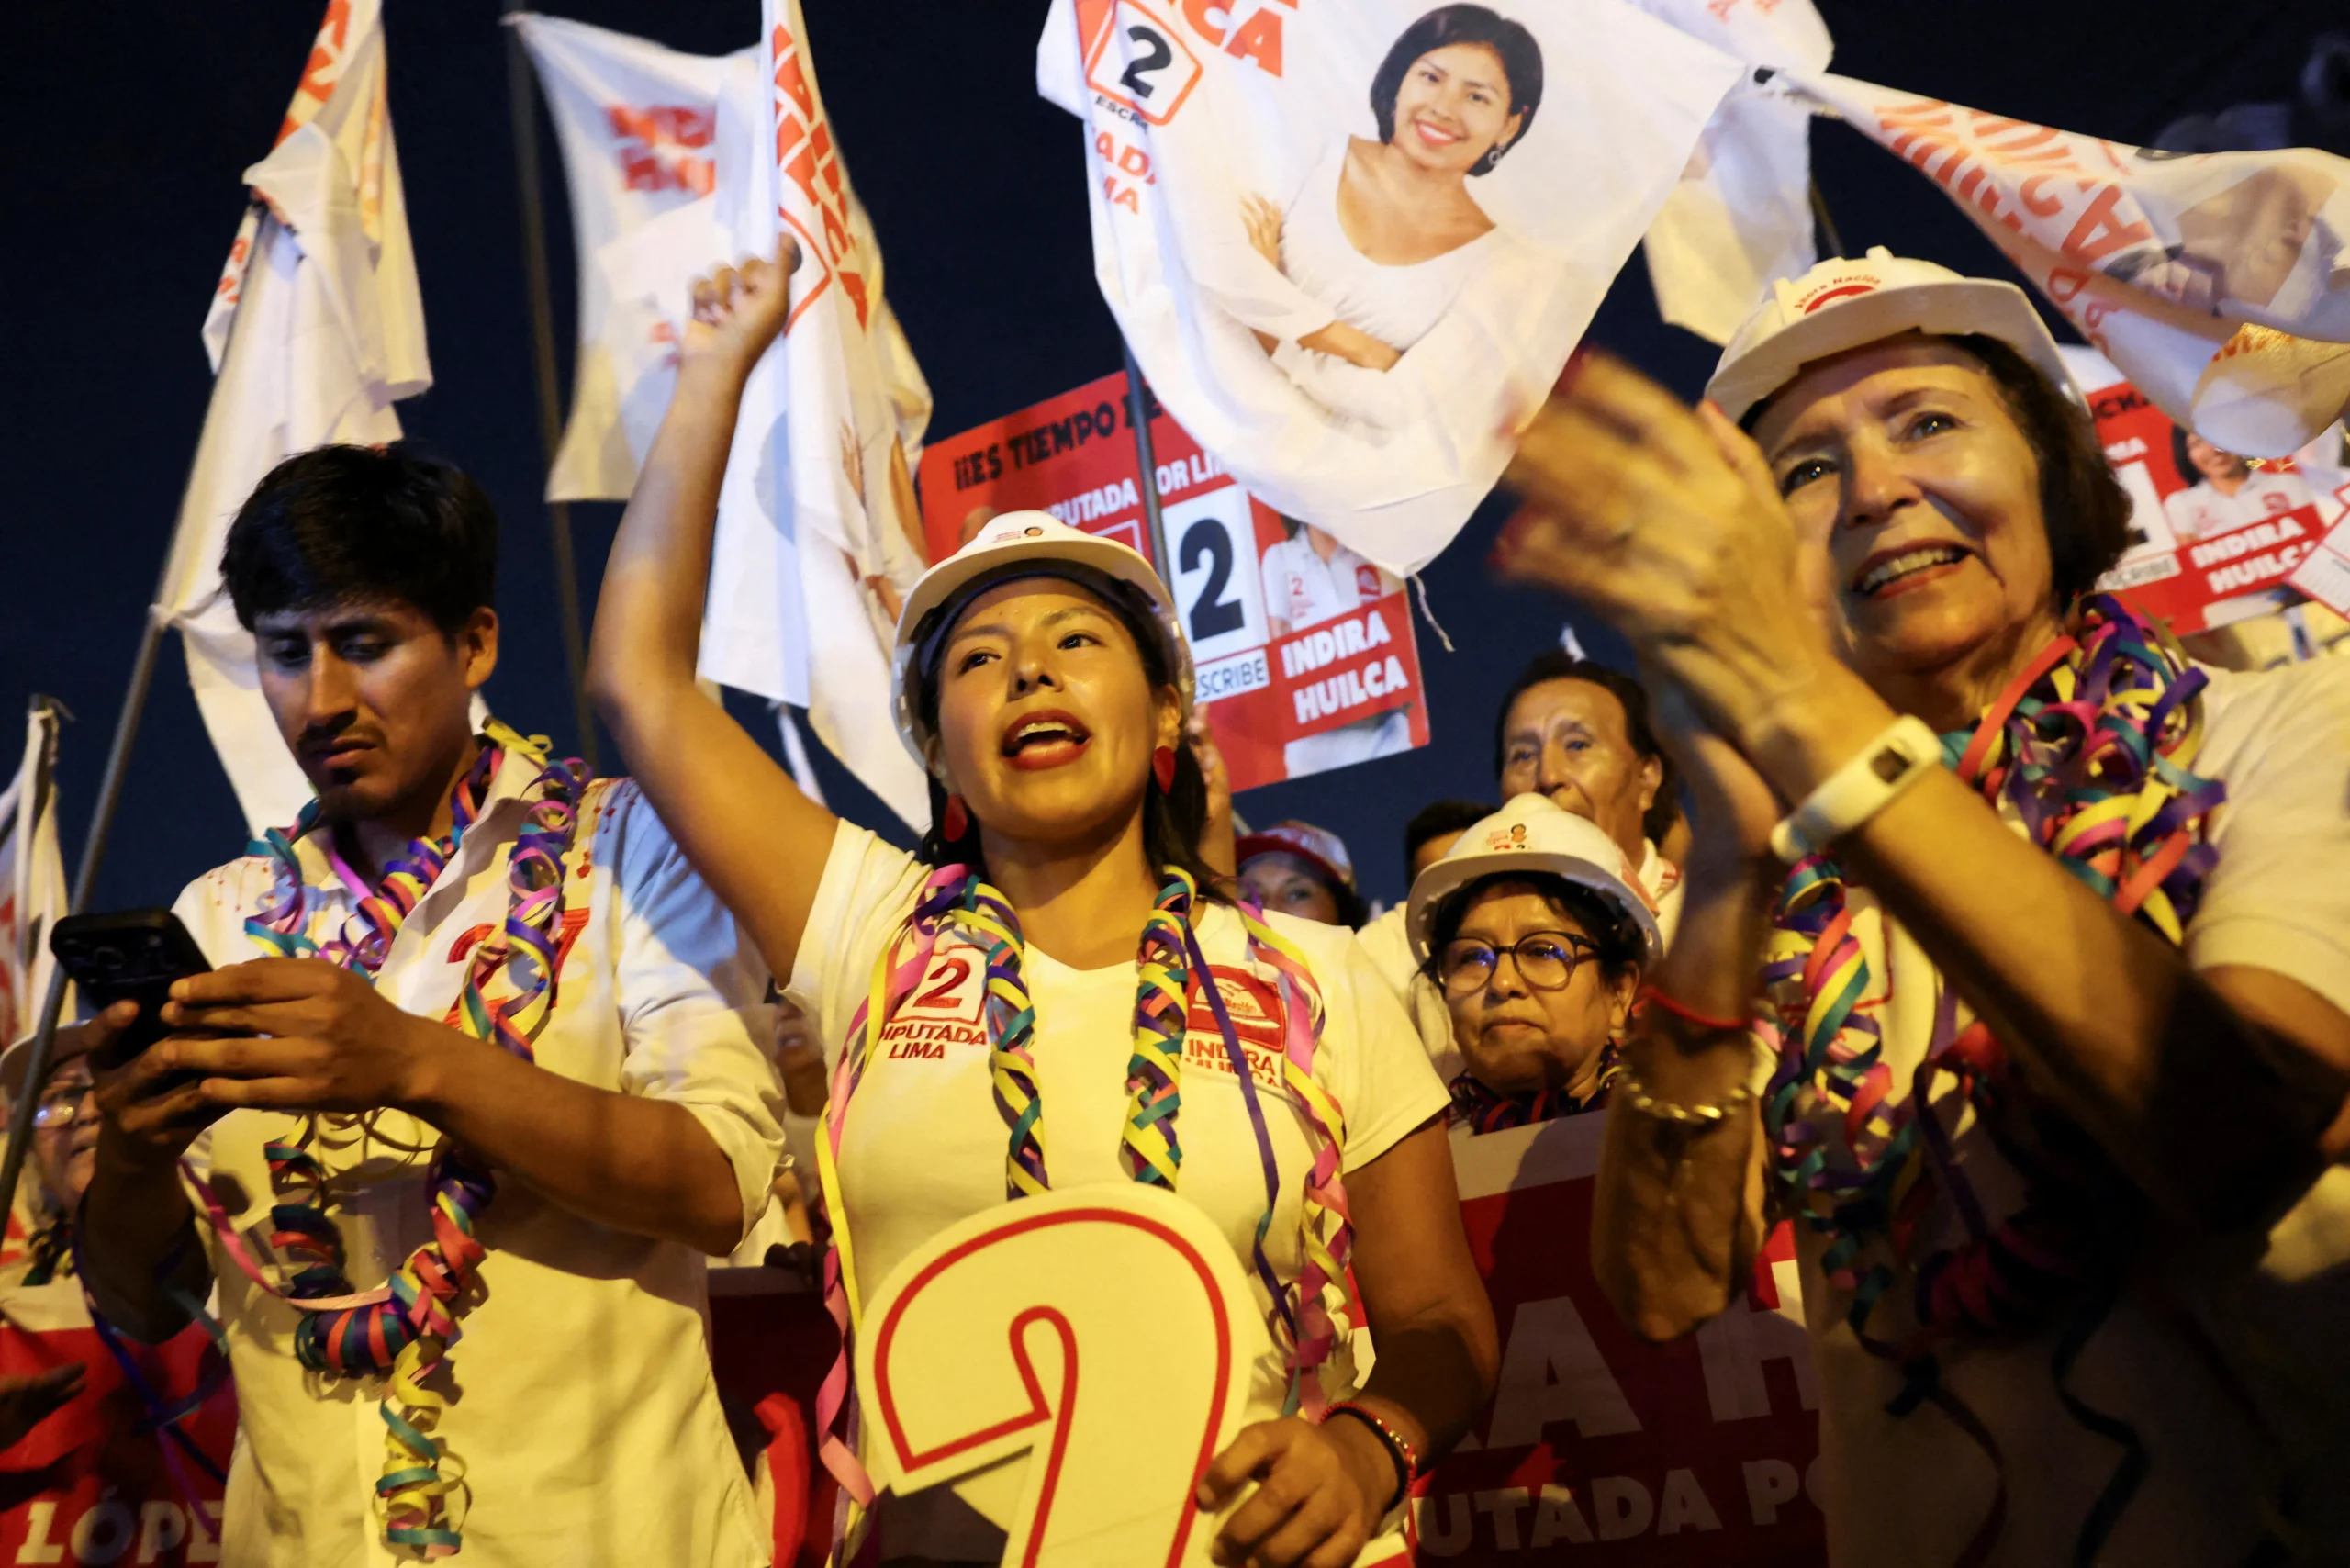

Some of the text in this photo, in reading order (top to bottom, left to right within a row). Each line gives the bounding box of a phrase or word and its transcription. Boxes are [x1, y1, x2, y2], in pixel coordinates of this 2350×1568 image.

[1119, 25, 1172, 99] 2
[1006, 400, 1116, 470] TIEMPO
[1045, 477, 1140, 527] PUTADA
[1155, 465, 1191, 496] OR
[2189, 516, 2306, 569] INDIRA
[1179, 517, 1246, 644] 2
[1281, 610, 1392, 679] INDIRA
[1195, 658, 1264, 700] SCRIBE
[1292, 655, 1409, 725] HUILCA
[912, 957, 971, 1008] 2
[888, 1041, 945, 1059] LIMA
[1188, 1038, 1277, 1076] INDRA
